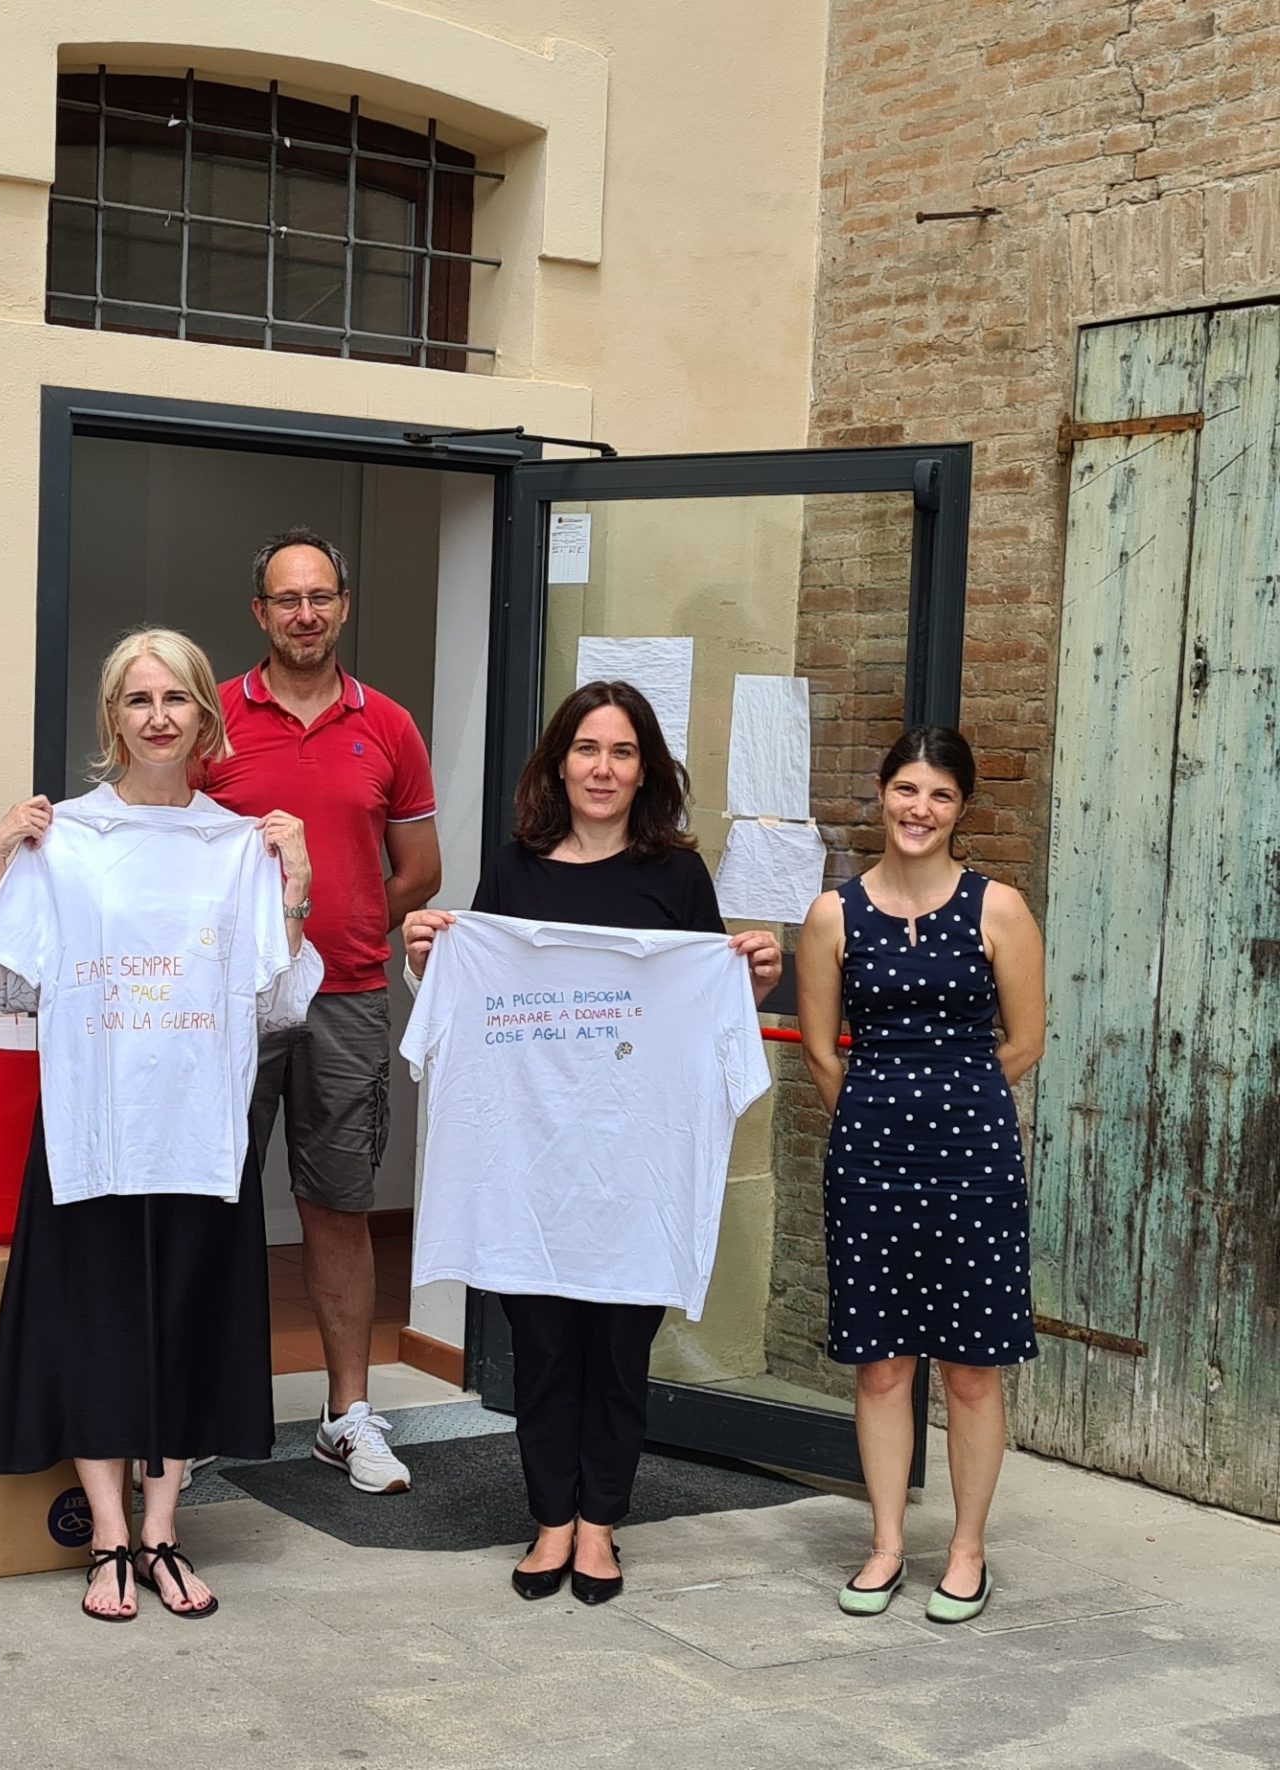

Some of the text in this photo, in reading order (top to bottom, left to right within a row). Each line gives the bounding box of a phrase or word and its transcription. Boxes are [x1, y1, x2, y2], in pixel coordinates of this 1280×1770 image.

[75, 956, 184, 986] FARE SEMPRE
[103, 984, 172, 1003] LA PACE
[486, 989, 632, 1011] DA PICCOLI BISOGNA
[86, 1011, 217, 1035] E NON LA GUERRA
[487, 1007, 643, 1027] IMPARARE A DONARE LE
[485, 1026, 619, 1045] COSE AGLI ALTRI
